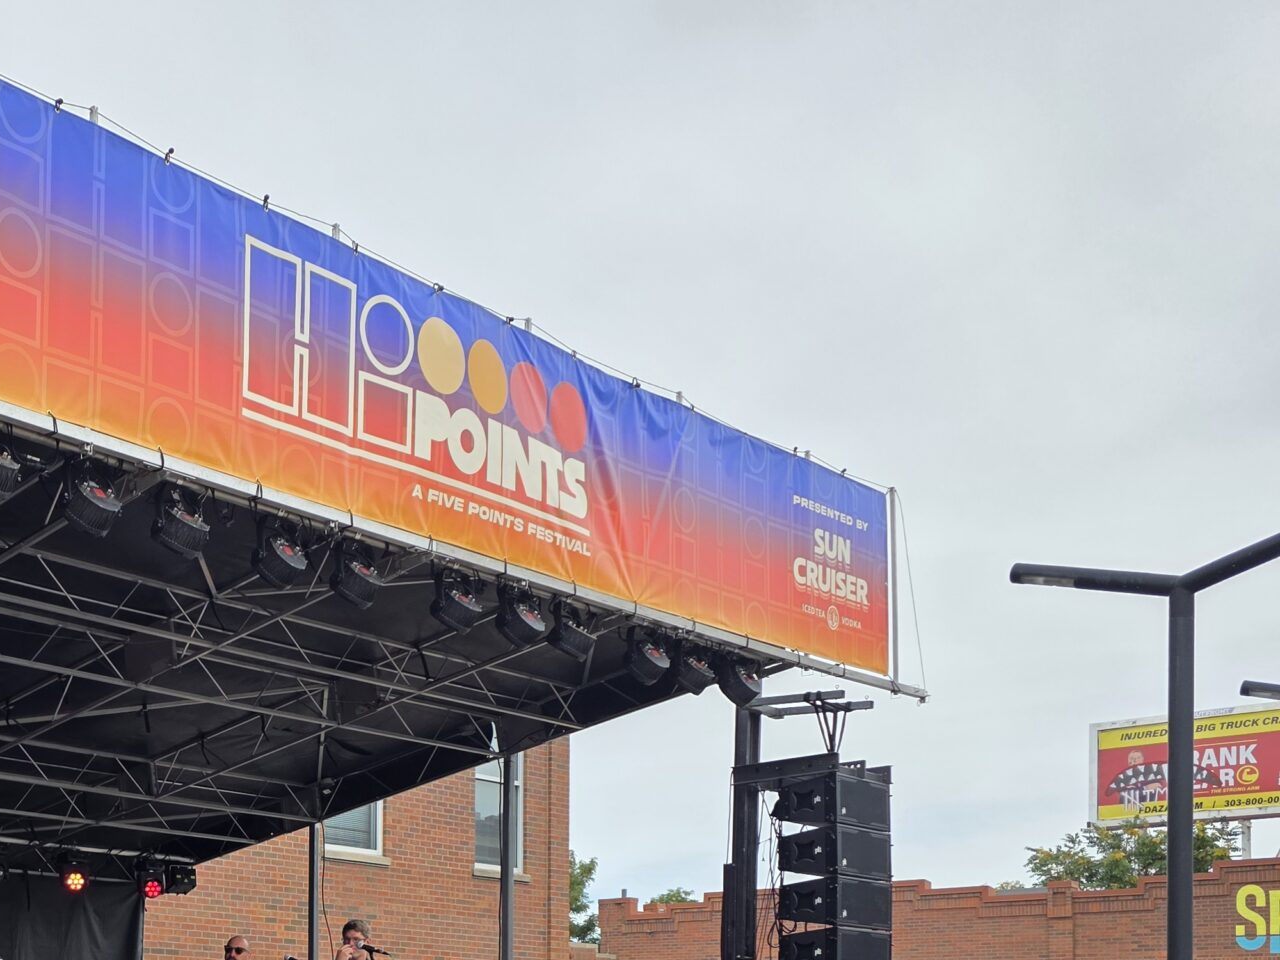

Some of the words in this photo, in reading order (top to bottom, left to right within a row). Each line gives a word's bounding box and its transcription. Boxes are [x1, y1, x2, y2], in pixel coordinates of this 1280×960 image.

[415, 389, 588, 520] POINTS
[412, 483, 424, 500] A
[427, 489, 464, 513] FIVE
[467, 503, 524, 533] POINTS
[527, 522, 592, 557] FESTIVAL
[793, 495, 853, 525] PRESENTED
[855, 519, 869, 532] BY
[814, 528, 852, 566] SUN
[793, 557, 870, 607] CRUISER
[841, 617, 862, 629] VODKA
[1120, 729, 1168, 741] INJURED
[1195, 723, 1216, 734] BIG
[1220, 718, 1259, 731] TRUCK
